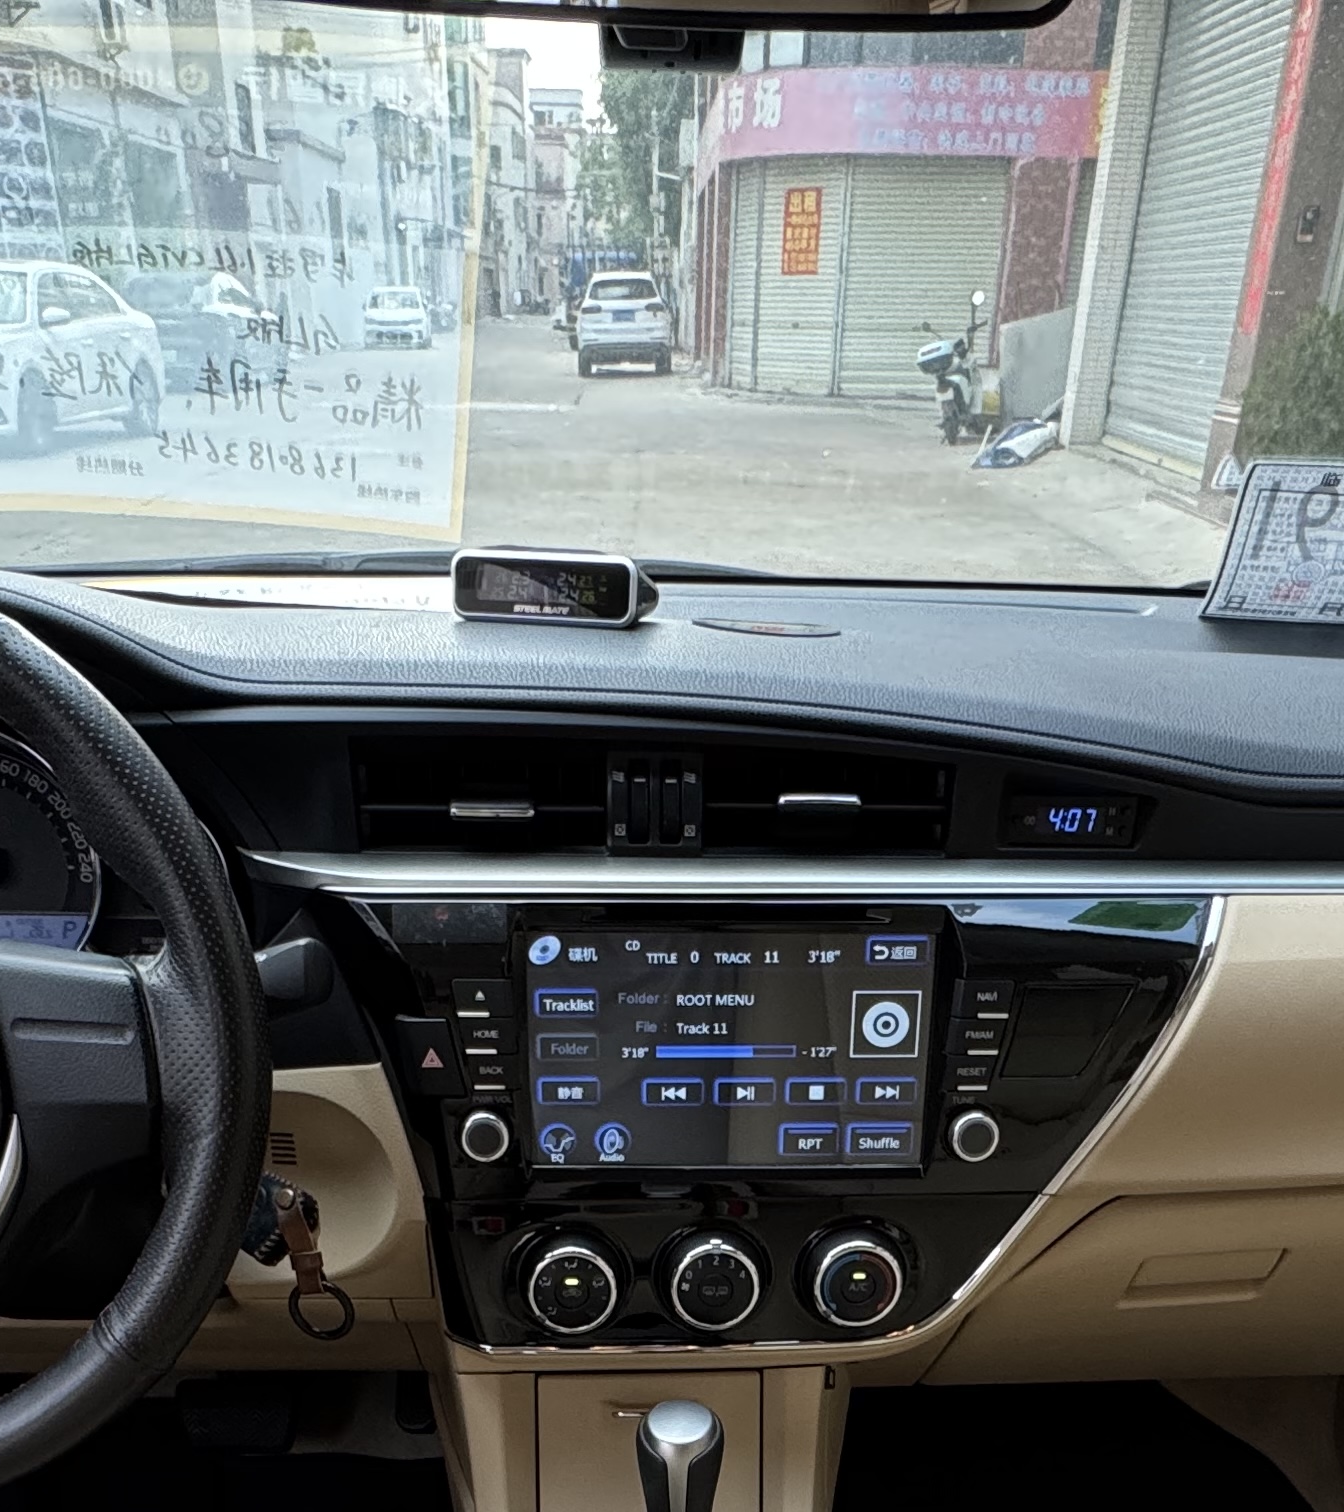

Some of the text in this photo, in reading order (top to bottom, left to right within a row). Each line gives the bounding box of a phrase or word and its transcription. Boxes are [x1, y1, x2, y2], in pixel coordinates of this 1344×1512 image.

[23, 769, 49, 794] 180
[47, 792, 72, 820] 200
[67, 821, 89, 850] 220
[78, 853, 94, 883] 240
[1048, 807, 1098, 833] 4:07
[62, 920, 77, 939] P
[625, 940, 641, 951] CD
[568, 948, 598, 962] 碟机
[646, 953, 678, 964] TITLE
[690, 951, 699, 964] 0
[714, 952, 751, 964] TRACK
[764, 951, 780, 964] 11
[890, 946, 917, 960] 返回
[676, 994, 712, 1006] ROOT
[715, 995, 755, 1006] MENU
[977, 992, 998, 1001] NAVI
[543, 998, 595, 1012] Tracklist
[473, 1030, 500, 1039] HOME
[677, 1022, 710, 1035] Track
[713, 1022, 728, 1035] 11
[550, 1043, 589, 1055] Folder
[479, 1066, 504, 1075] BACK
[957, 1067, 987, 1077] RESET
[798, 1137, 823, 1150] RPT
[858, 1137, 900, 1150] Shuffle
[551, 1153, 565, 1164] EQ
[599, 1153, 625, 1163] Audio
[712, 1255, 720, 1266] 2
[849, 1283, 868, 1292] A/C
